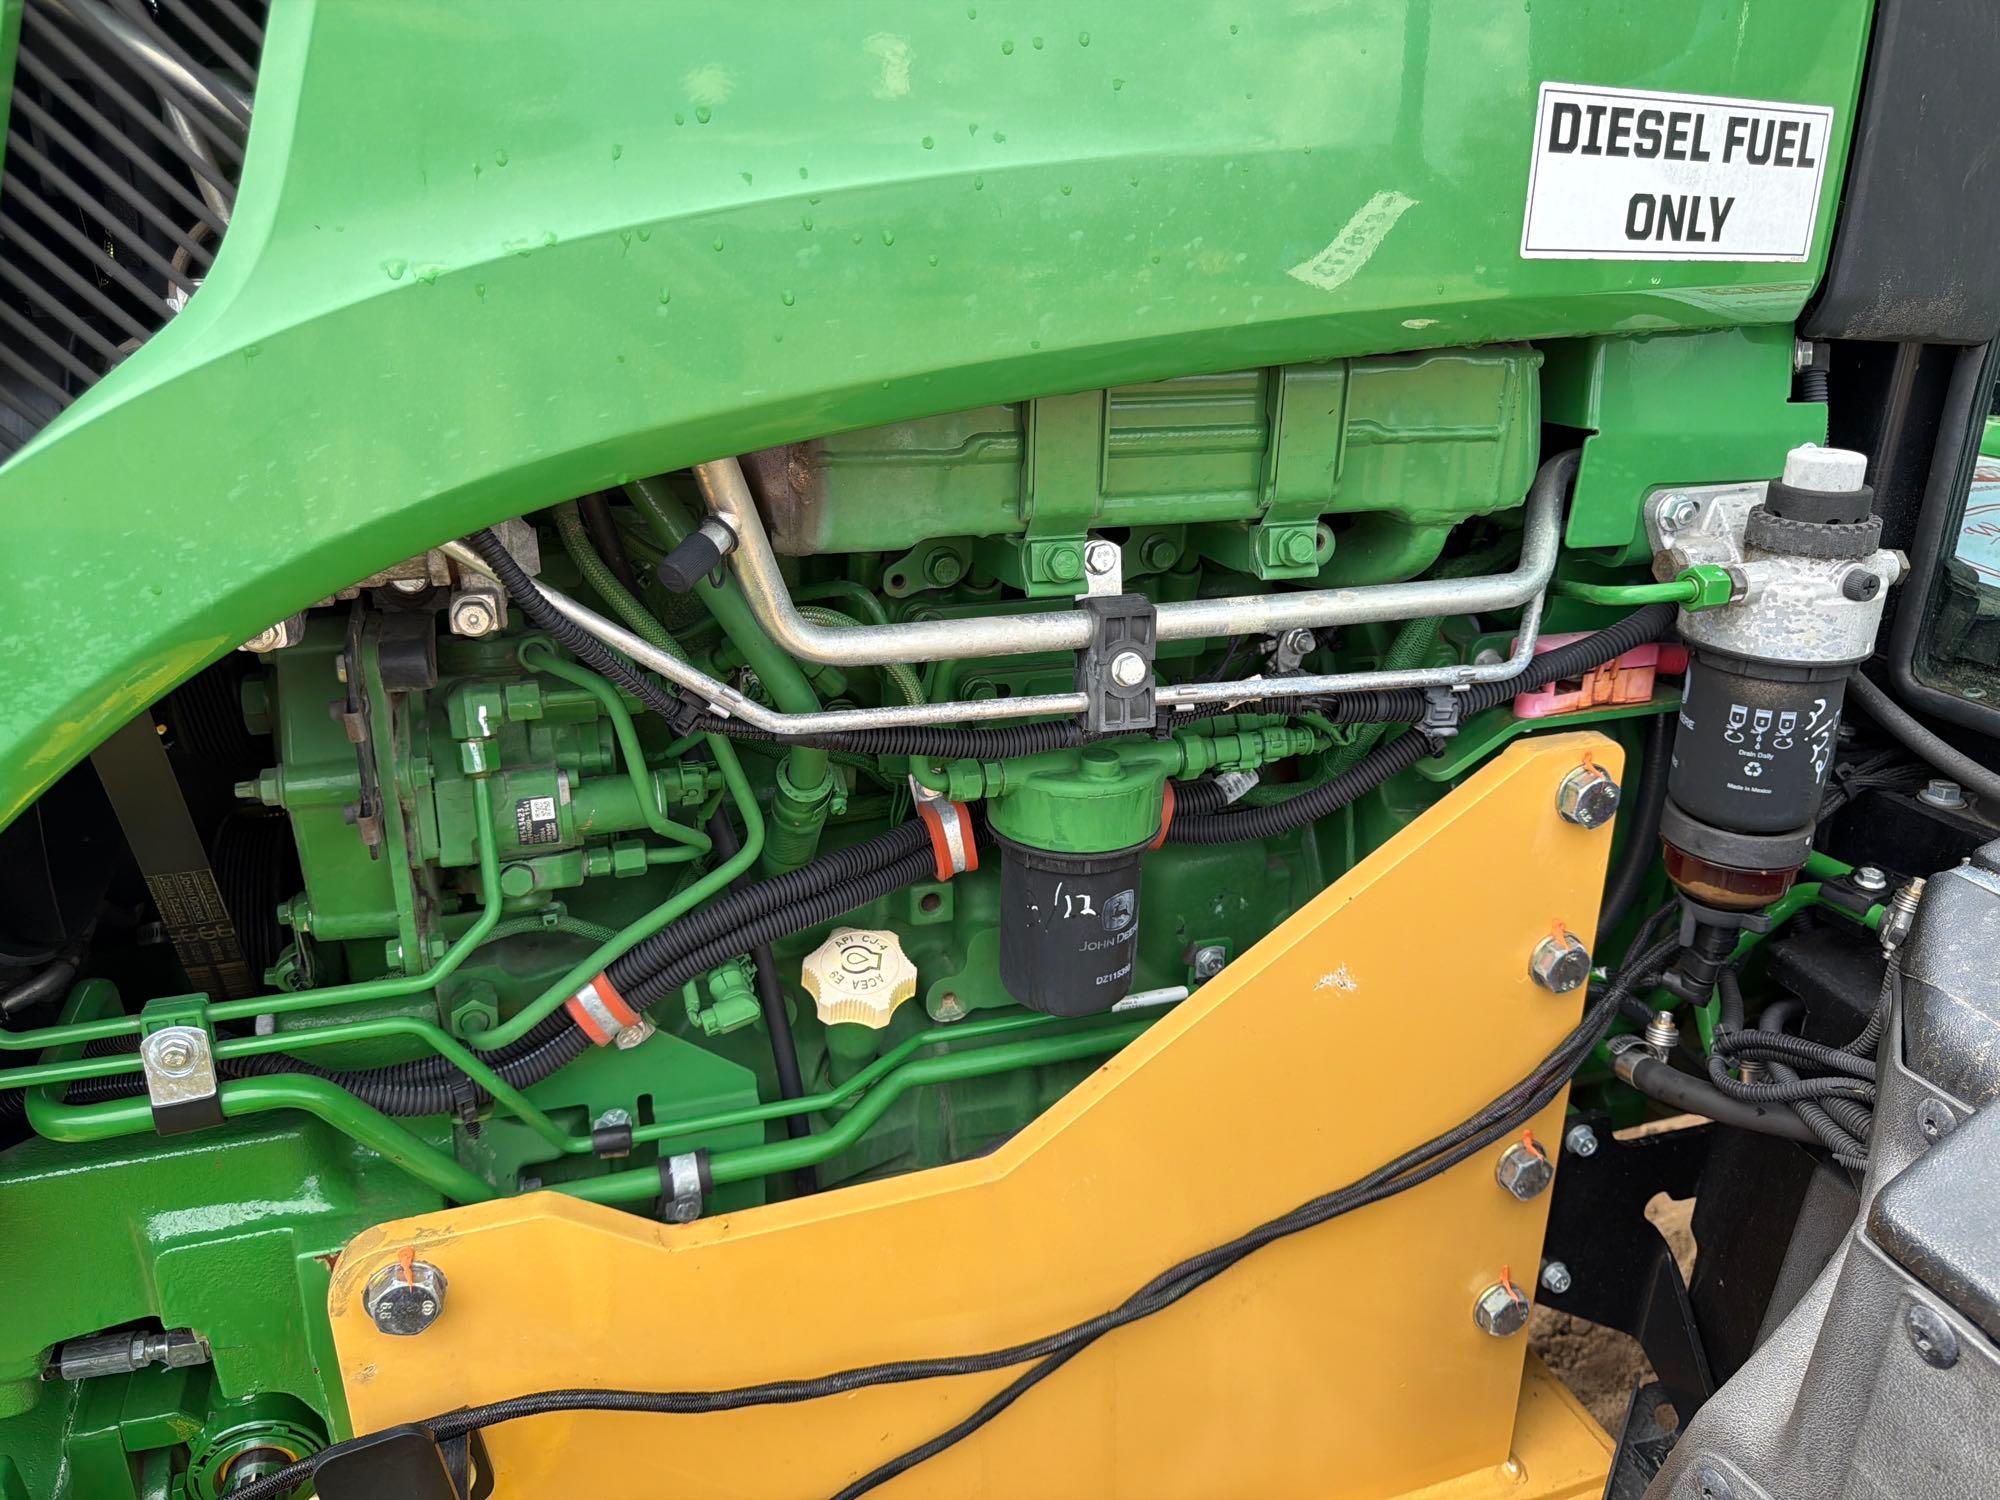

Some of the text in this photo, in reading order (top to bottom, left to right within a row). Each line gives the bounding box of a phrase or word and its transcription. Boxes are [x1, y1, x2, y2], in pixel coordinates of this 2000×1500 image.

[1548, 102, 1815, 168] DIESEL FUEL
[1624, 193, 1736, 242] ONLY
[1738, 749, 1774, 760] Drain Daily
[1727, 782, 1744, 791] Made
[1751, 786, 1772, 794] Mexico
[835, 935, 888, 950] API CJ-4
[1079, 938, 1115, 952] JOHN
[829, 970, 884, 990] ACEA E9
